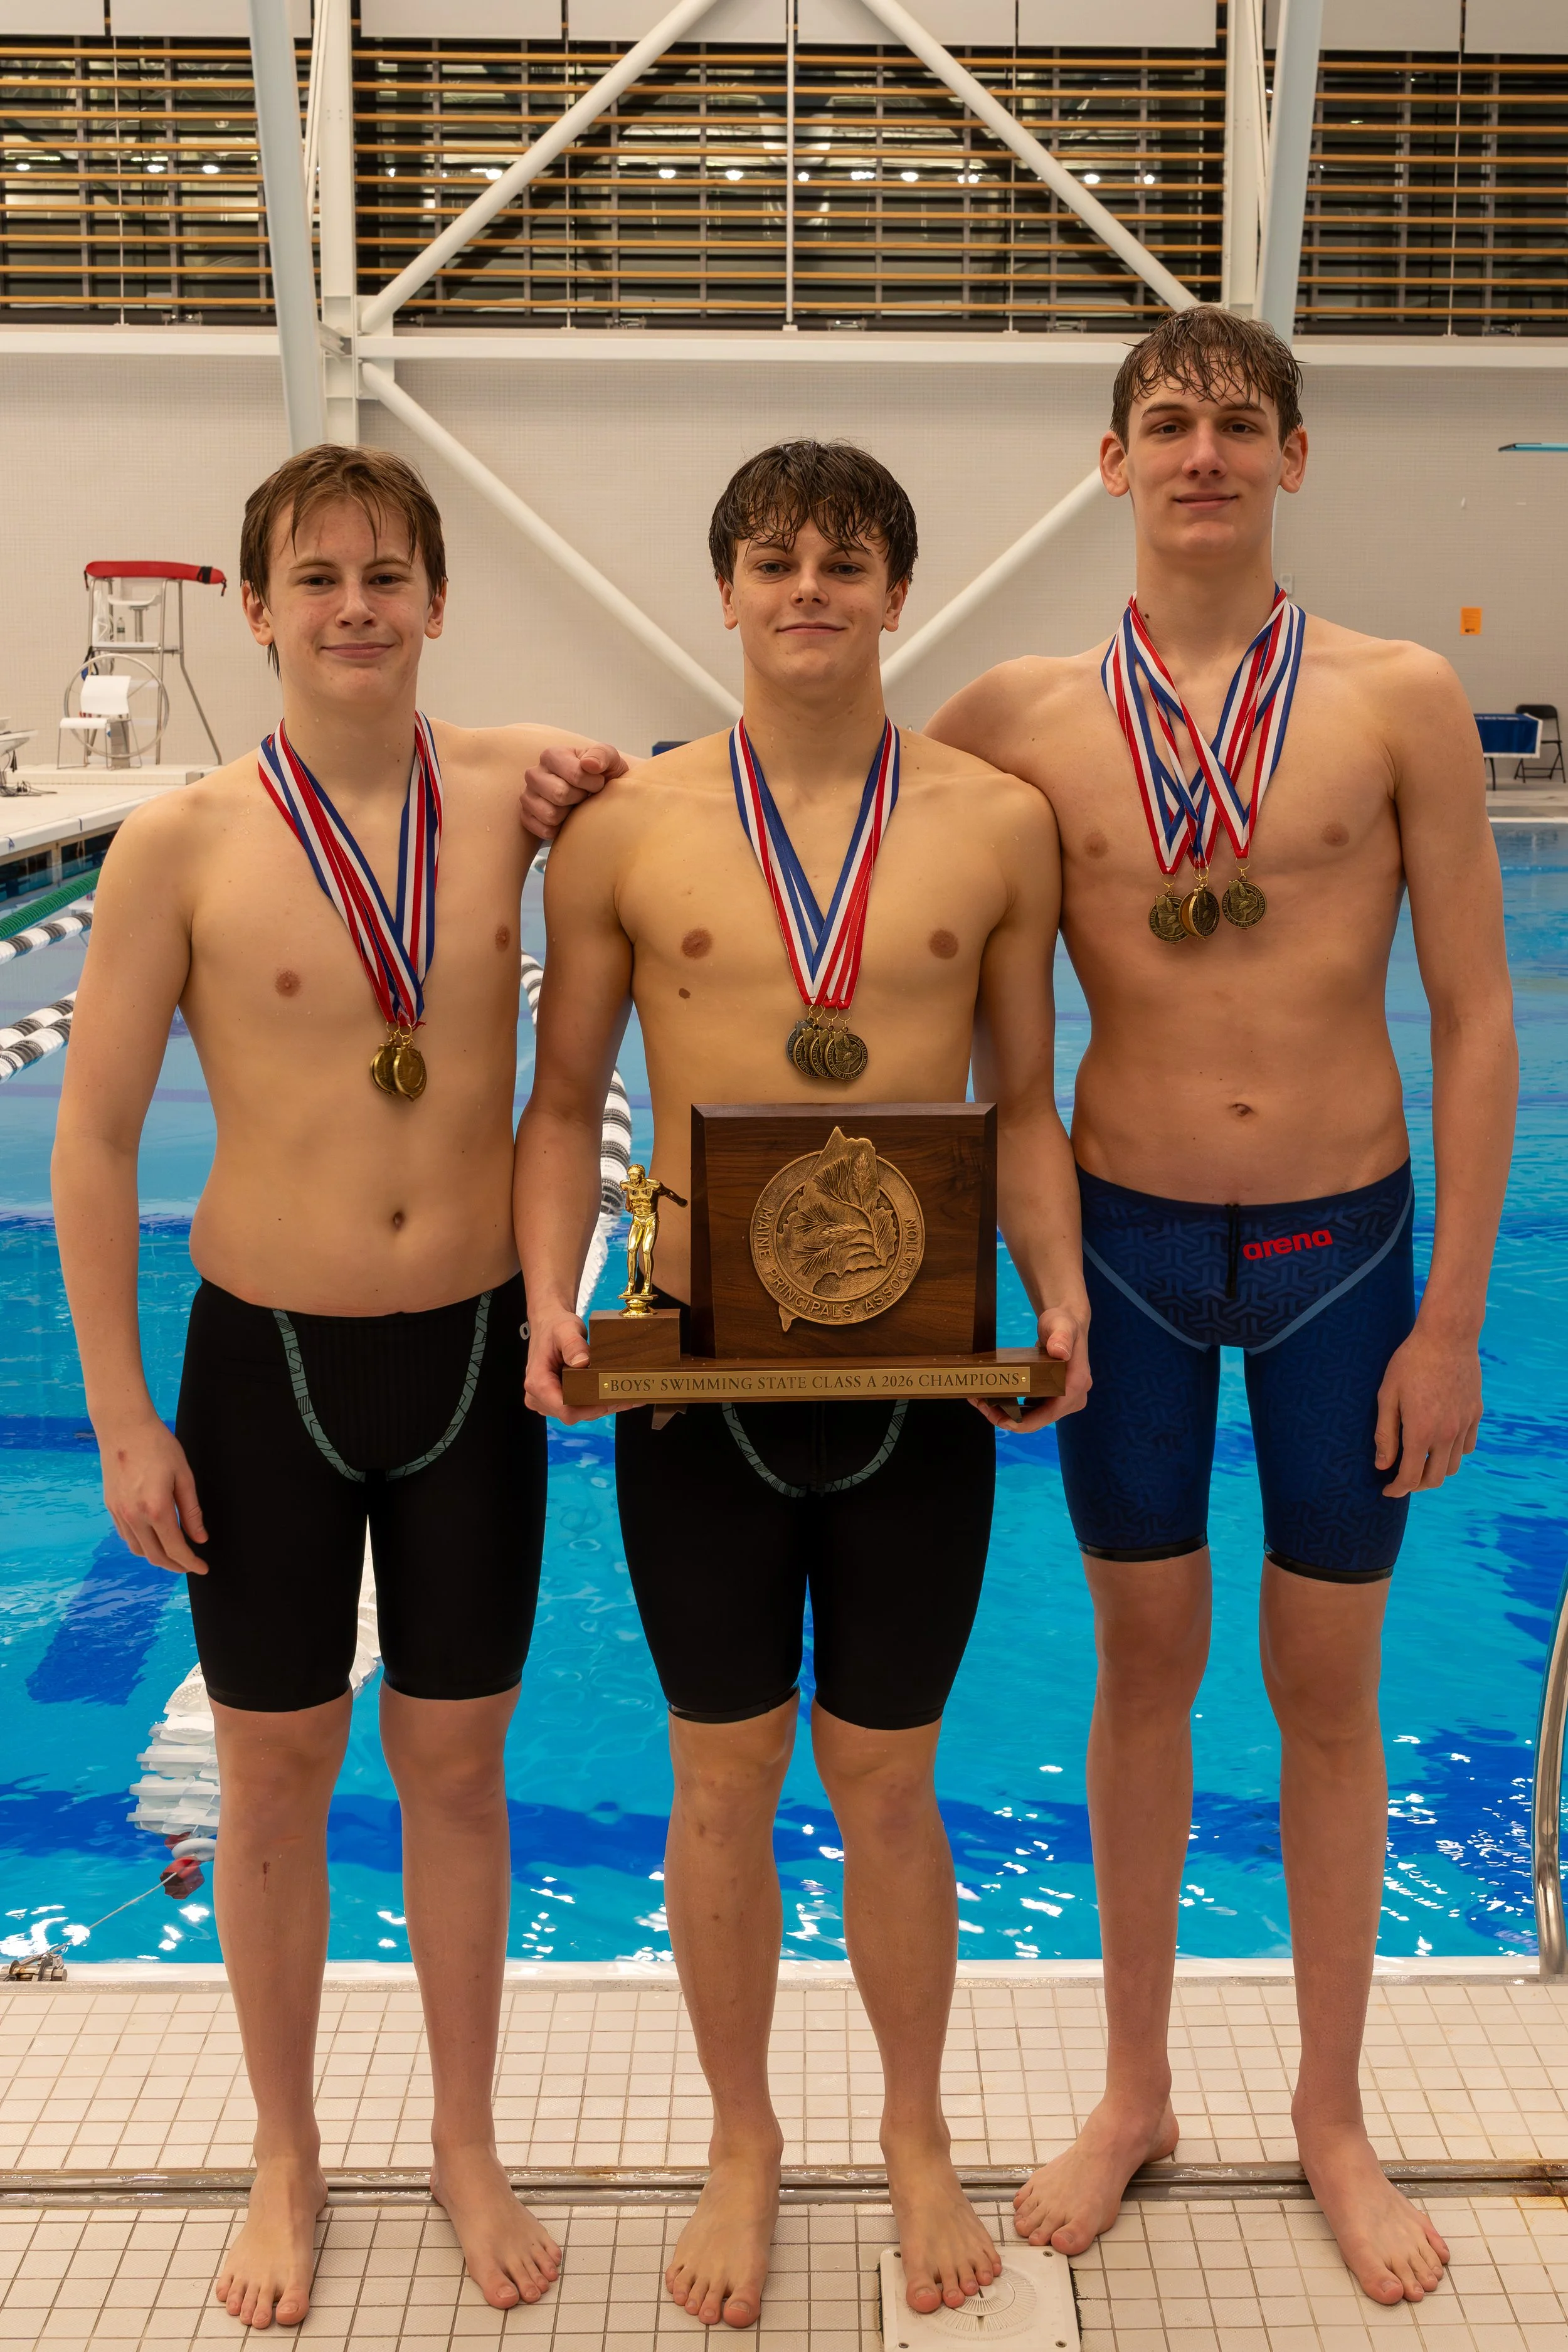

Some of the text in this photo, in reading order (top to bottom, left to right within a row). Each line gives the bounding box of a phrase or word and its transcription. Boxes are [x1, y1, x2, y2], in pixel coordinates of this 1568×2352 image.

[1242, 1229, 1333, 1260] arena
[756, 1207, 918, 1318] MAINE PRINCIPALS' ASSOCIATION
[610, 1373, 1020, 1392] BOYS' SWIMMING STATE CLASS A 2026 CHAMPIONS
